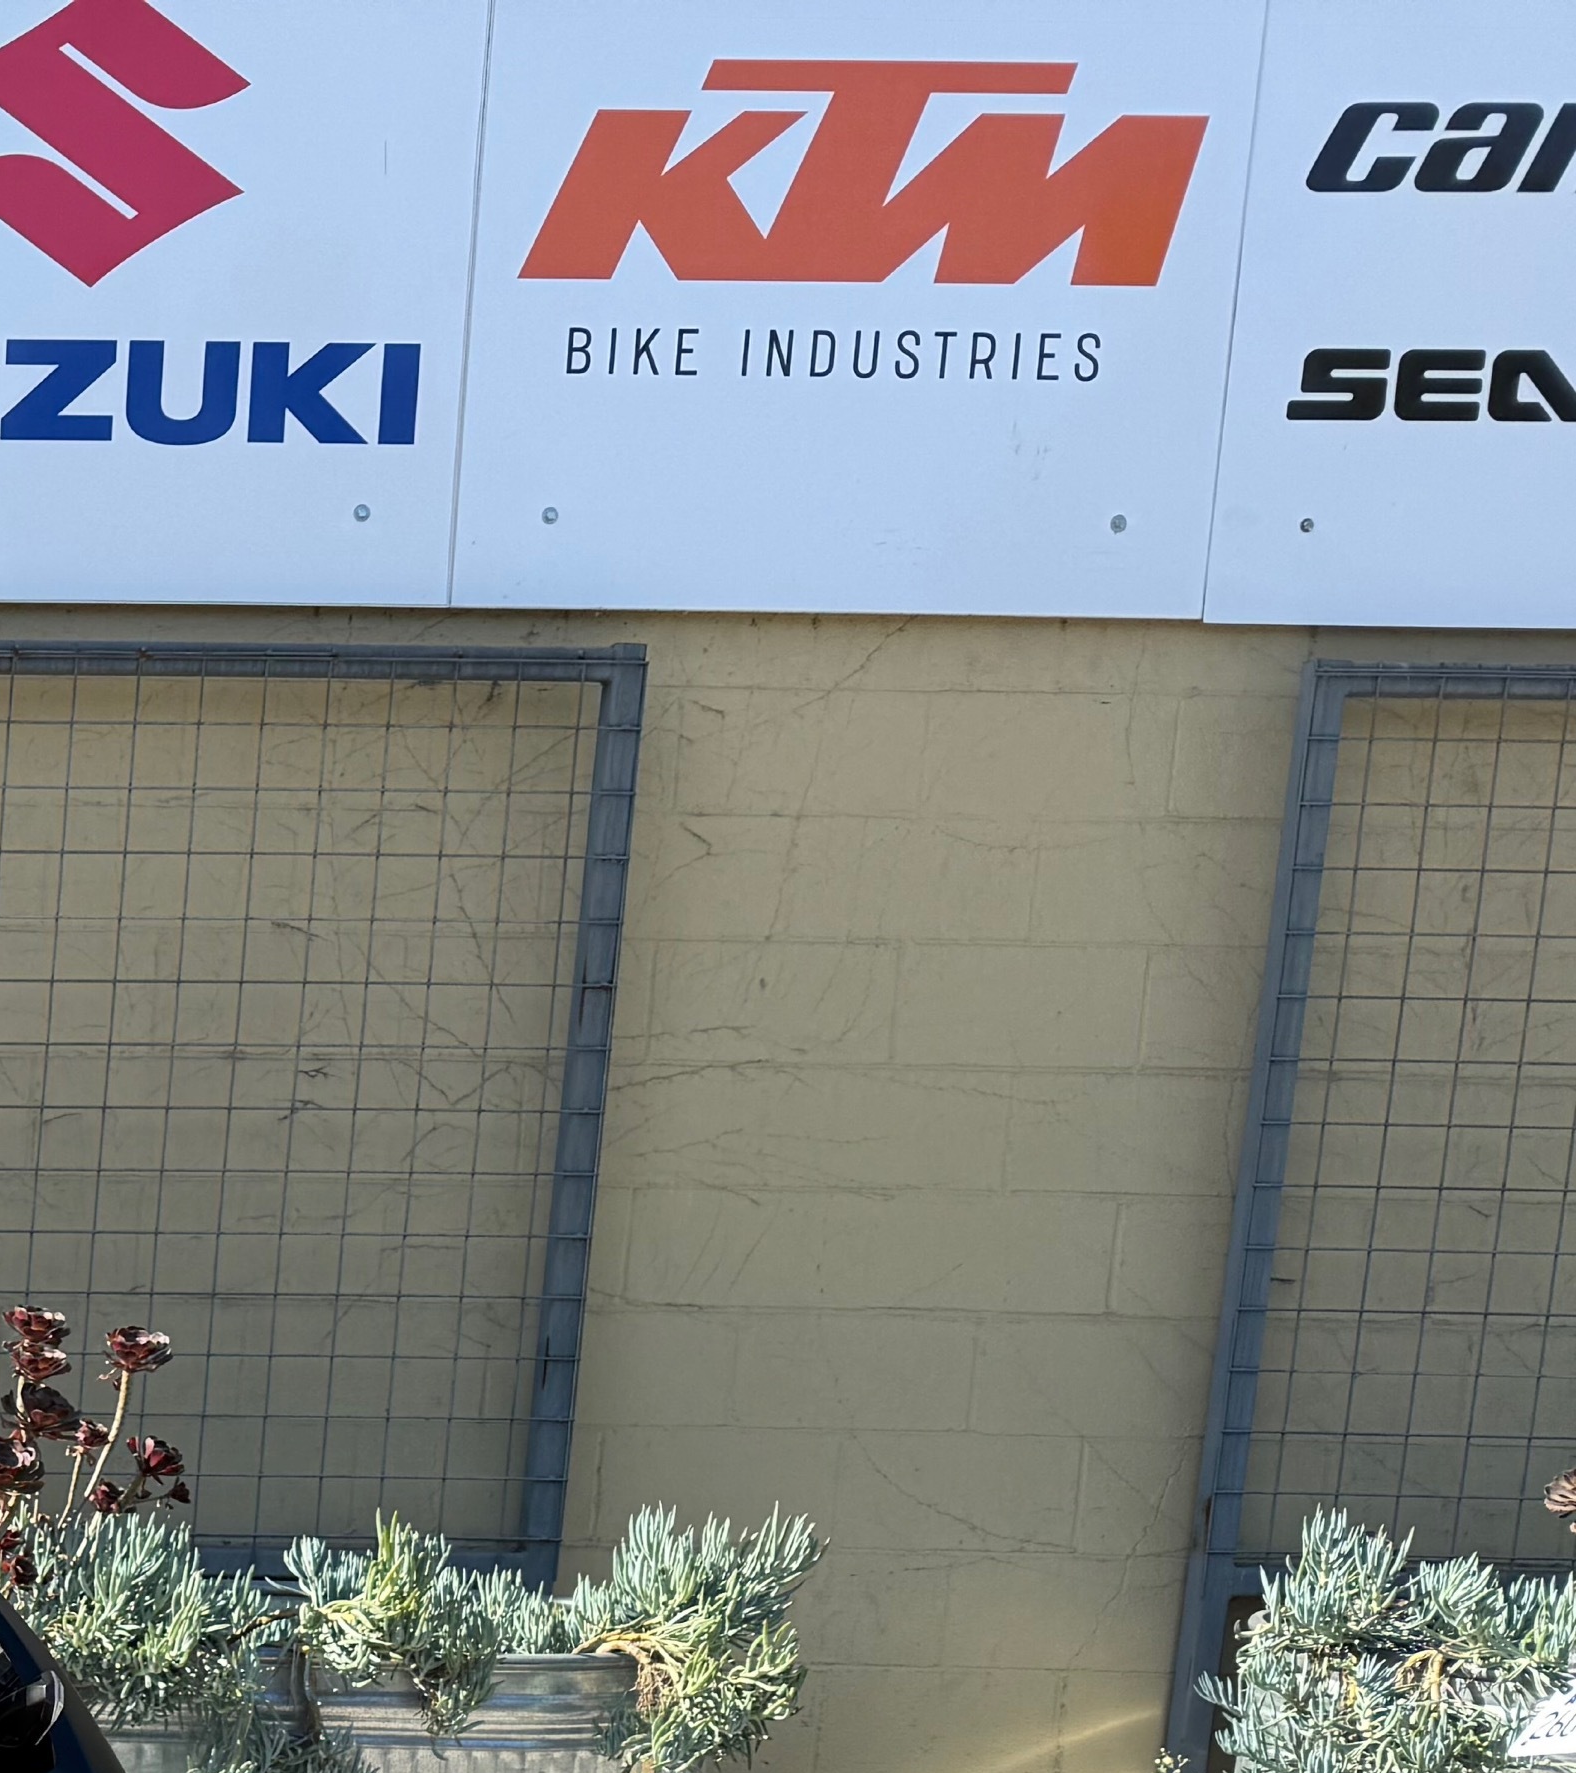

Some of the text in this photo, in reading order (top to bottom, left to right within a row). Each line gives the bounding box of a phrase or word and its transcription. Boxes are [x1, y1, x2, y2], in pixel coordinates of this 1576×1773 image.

[520, 60, 1207, 286] KTM
[567, 328, 1100, 381] BIKE INDUSTRIES
